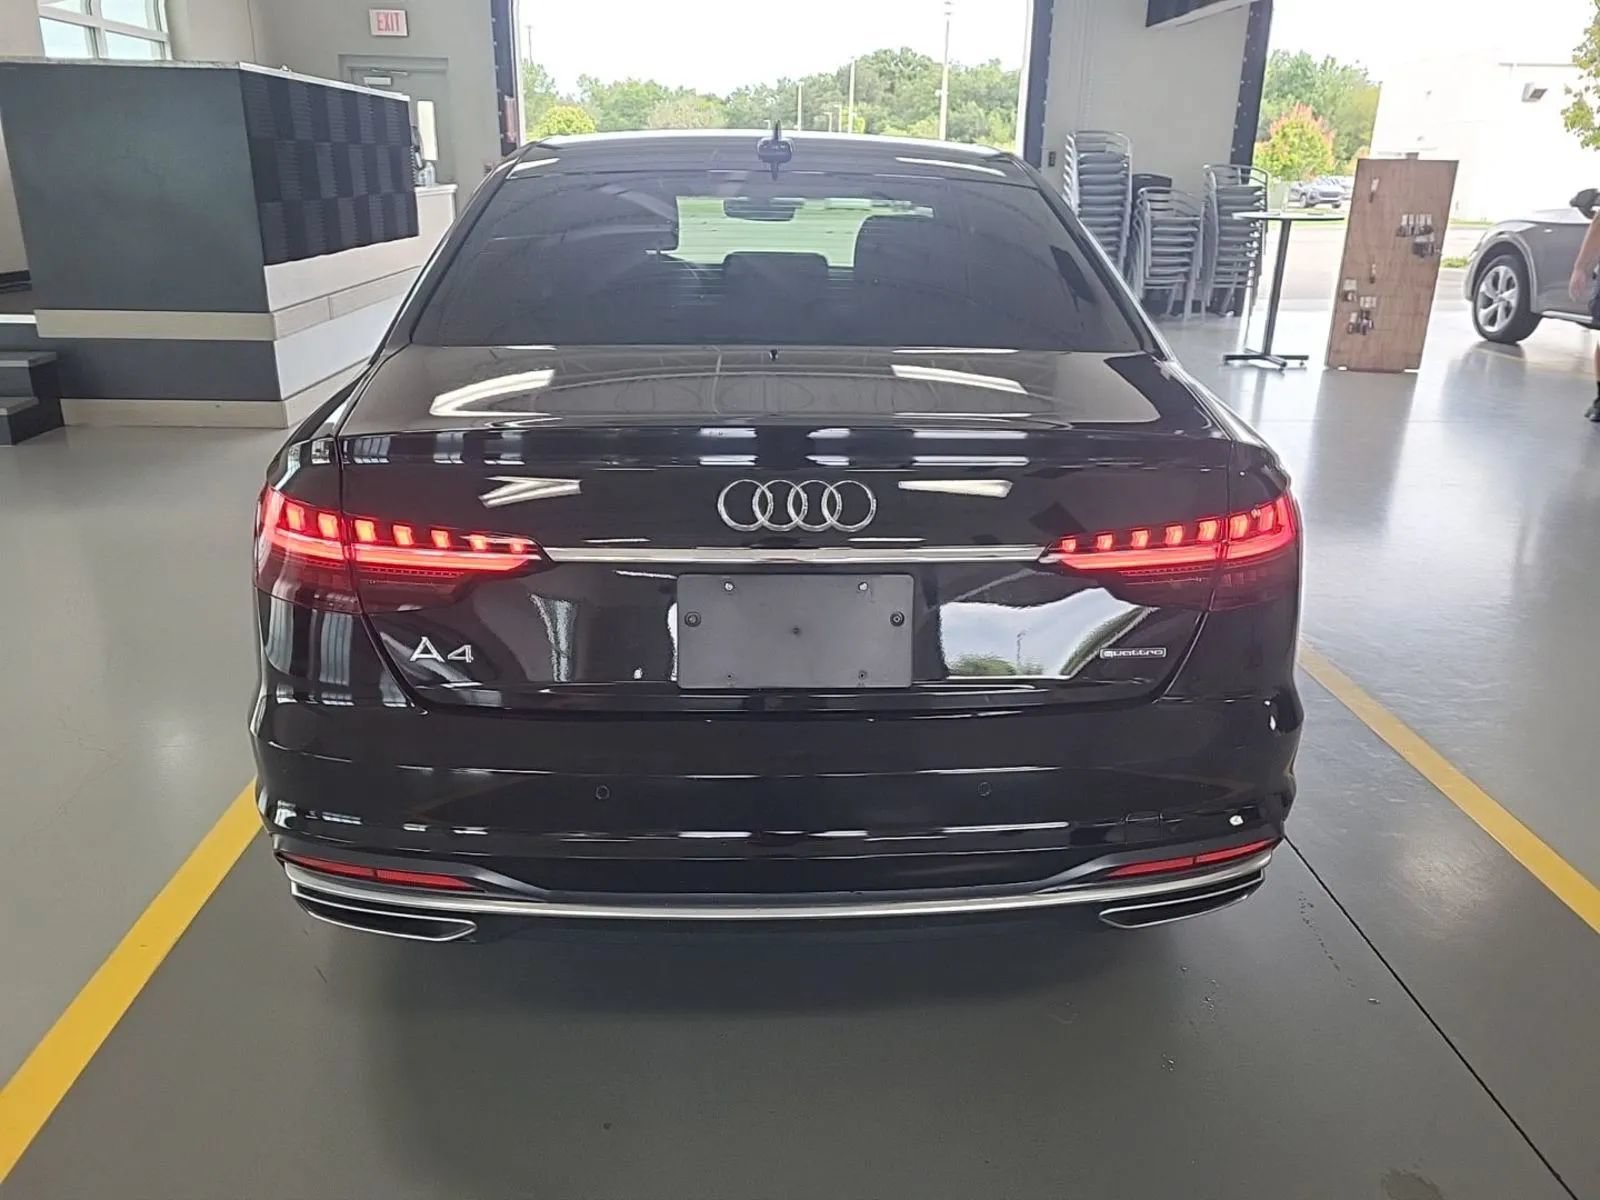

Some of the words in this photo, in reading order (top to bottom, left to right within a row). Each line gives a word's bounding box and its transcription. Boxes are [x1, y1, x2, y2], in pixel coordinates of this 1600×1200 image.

[376, 12, 400, 32] EXIT
[409, 636, 474, 663] A4
[1103, 649, 1163, 658] quattro
